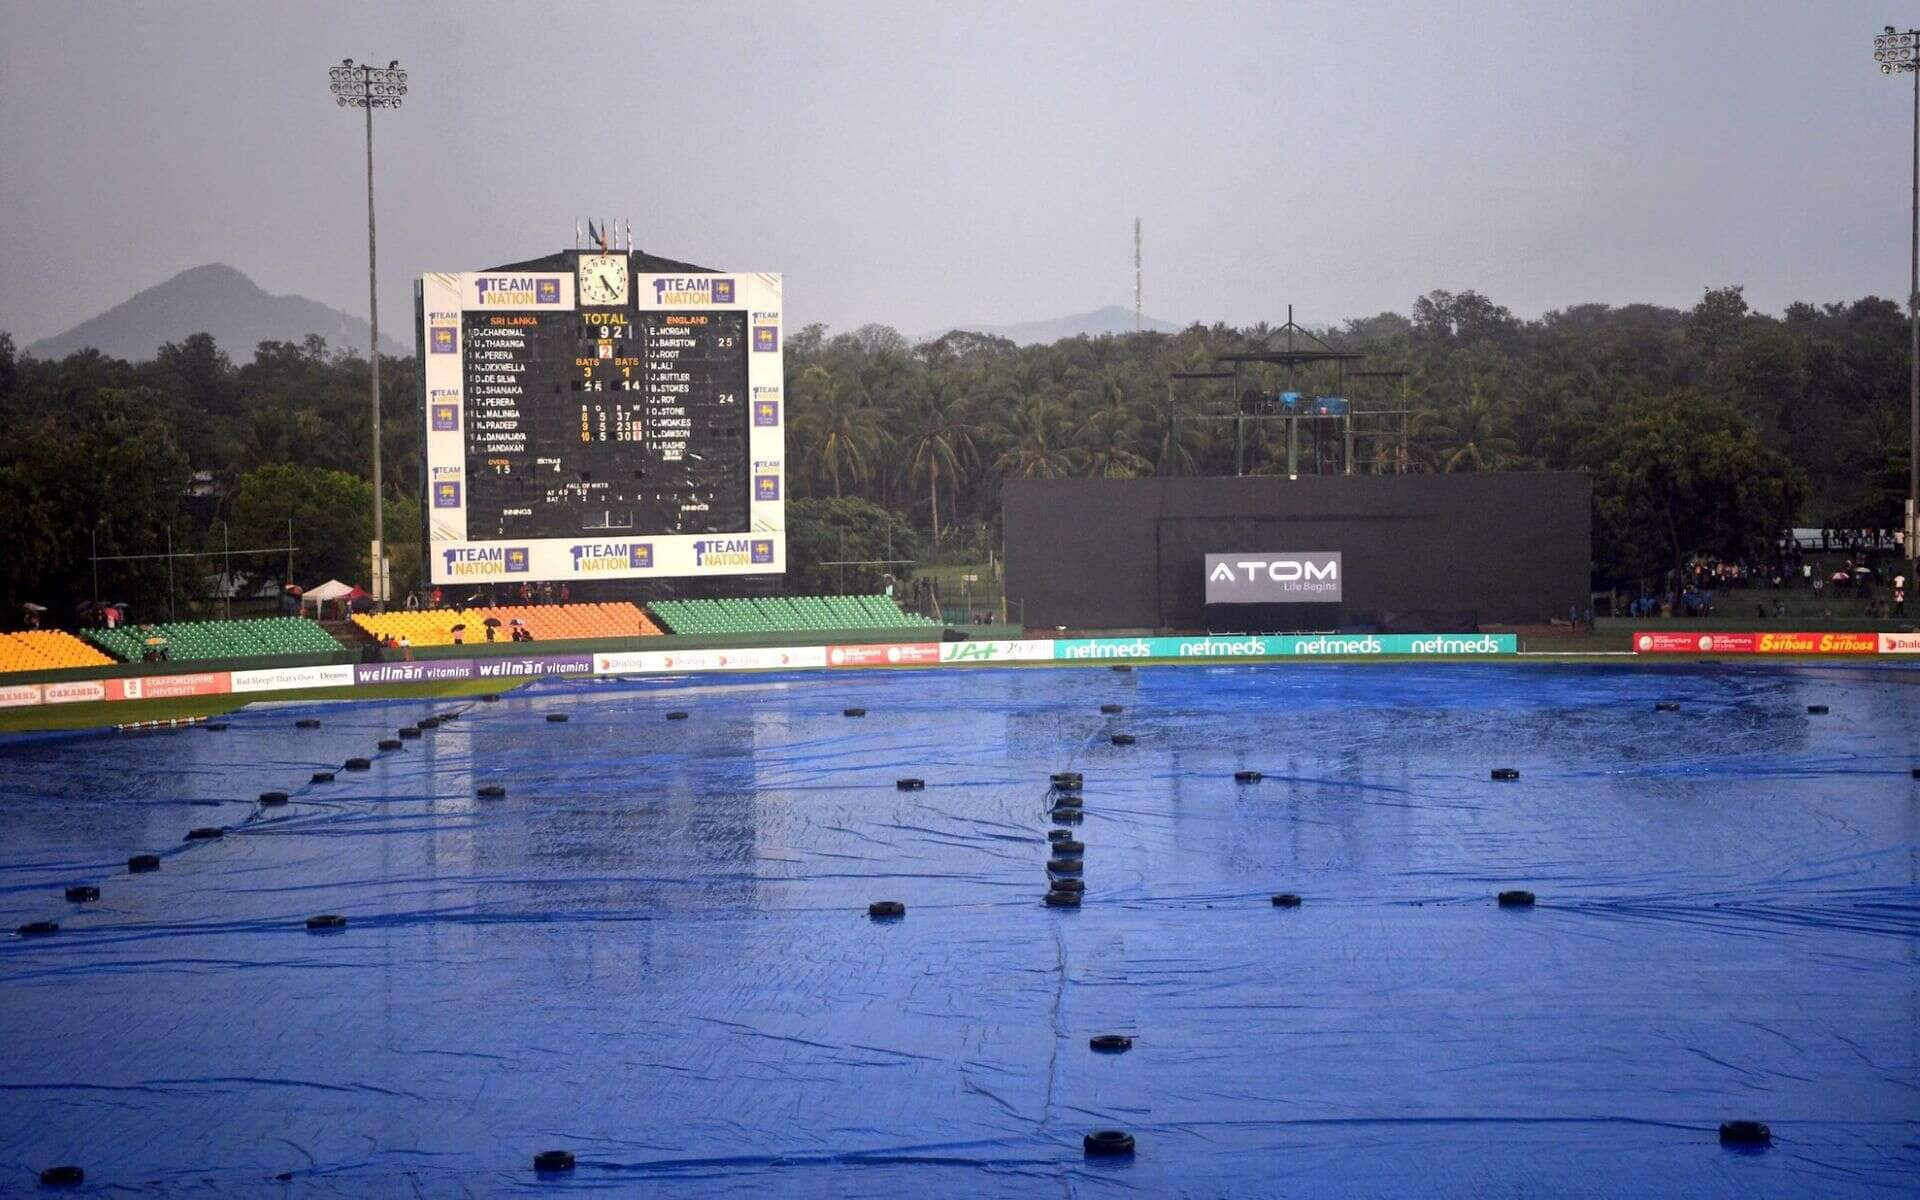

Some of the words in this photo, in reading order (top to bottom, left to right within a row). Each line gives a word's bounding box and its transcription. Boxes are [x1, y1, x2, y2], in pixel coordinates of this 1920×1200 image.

[488, 278, 534, 291] TEAM
[666, 279, 709, 291] TEAM
[487, 292, 534, 304] NATION
[665, 292, 709, 304] NATION
[490, 317, 504, 325] SRI
[507, 317, 537, 325] LANKA
[583, 313, 628, 324] TOTAL
[666, 316, 708, 325] ENGLAND
[650, 350, 679, 358] J.ROOT
[576, 358, 600, 366] BATS
[615, 358, 640, 366] BATS
[584, 367, 592, 377] 3
[623, 367, 630, 377] 1
[622, 380, 640, 390] 14
[719, 395, 734, 403] 24
[600, 412, 606, 421] 5
[600, 422, 606, 431] 5
[600, 432, 606, 441] 5
[583, 544, 627, 557] TEAM
[705, 540, 748, 553] TEAM
[456, 548, 502, 561] TEAM
[704, 553, 748, 567] NATION
[455, 562, 502, 575] NATION
[582, 557, 628, 571] NATION
[1210, 561, 1337, 582] ATOM
[1284, 583, 1301, 592] Life
[1303, 582, 1336, 593] Begins
[1066, 639, 1150, 658] netmeds
[1180, 636, 1265, 655] netmeds
[1296, 635, 1381, 654] netmeds
[1412, 635, 1498, 653] netmeds
[426, 667, 470, 678] vitamins
[546, 662, 589, 673] vitamins
